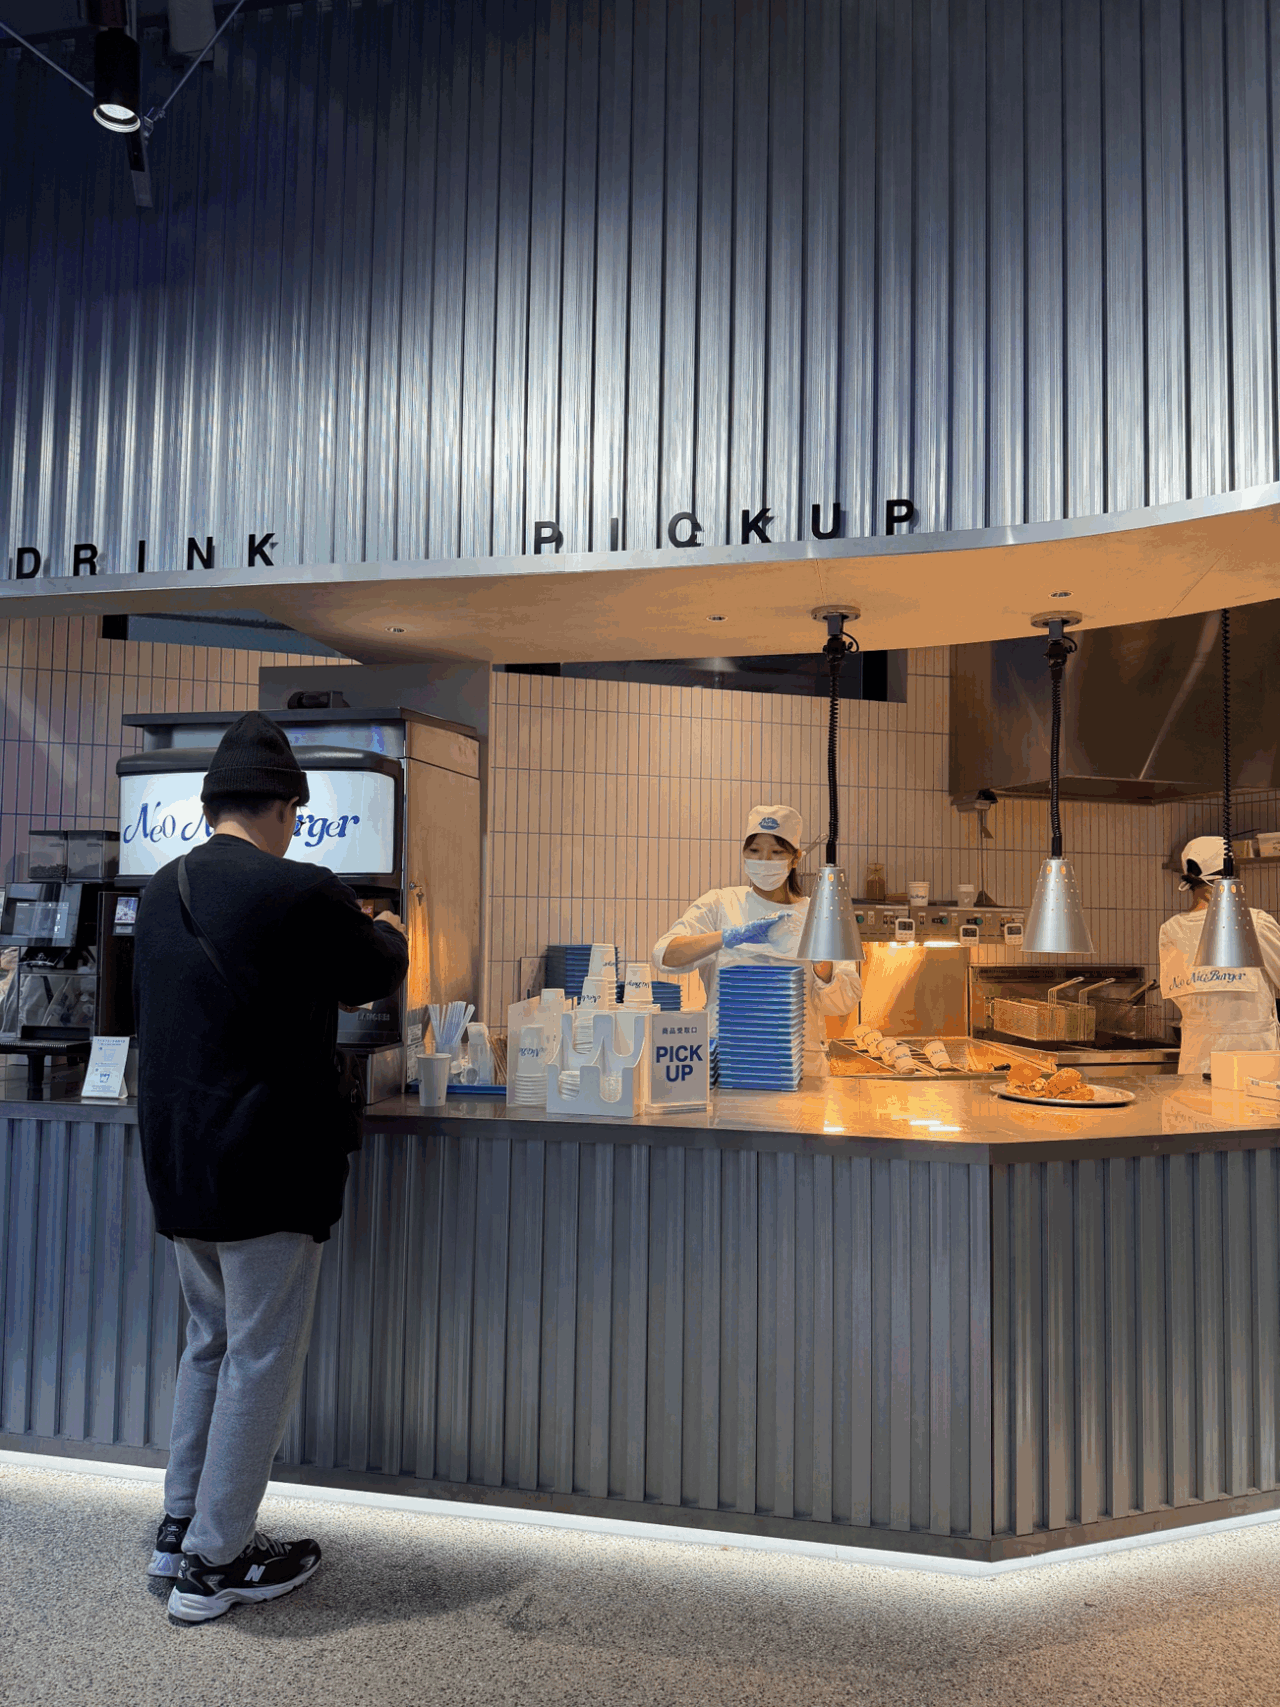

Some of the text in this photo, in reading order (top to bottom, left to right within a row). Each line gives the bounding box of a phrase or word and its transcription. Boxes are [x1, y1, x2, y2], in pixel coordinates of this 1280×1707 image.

[16, 533, 277, 580] DRINK
[123, 801, 176, 844] Neo
[293, 814, 360, 848] rger
[656, 1044, 703, 1063] PICK
[666, 1064, 693, 1082] UP
